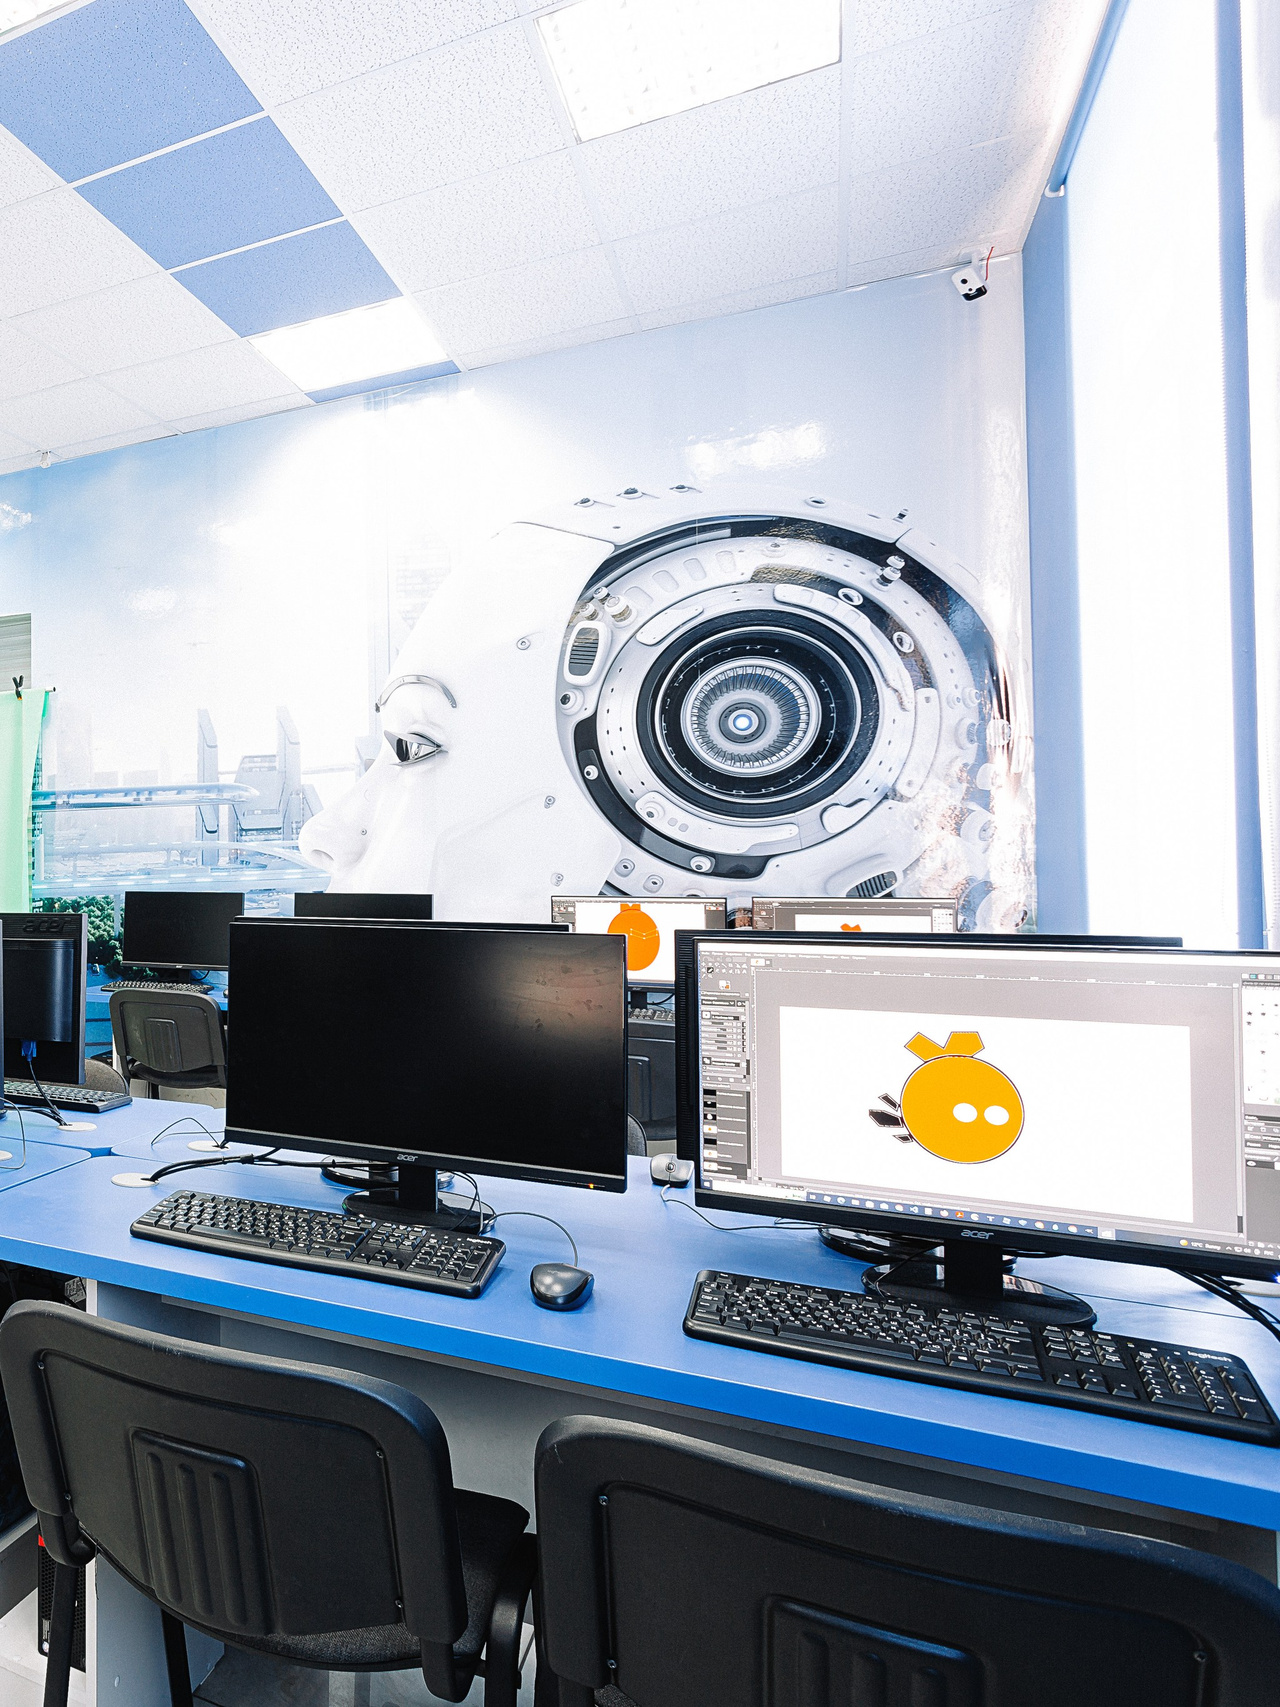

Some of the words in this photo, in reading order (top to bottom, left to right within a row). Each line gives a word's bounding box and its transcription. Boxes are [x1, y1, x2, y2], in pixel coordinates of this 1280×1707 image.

[23, 917, 71, 933] acer
[397, 1153, 418, 1162] acer
[961, 1229, 994, 1240] acer
[466, 1237, 493, 1246] logitech
[1205, 1243, 1221, 1251] Sunny
[1187, 1350, 1233, 1363] logitech
